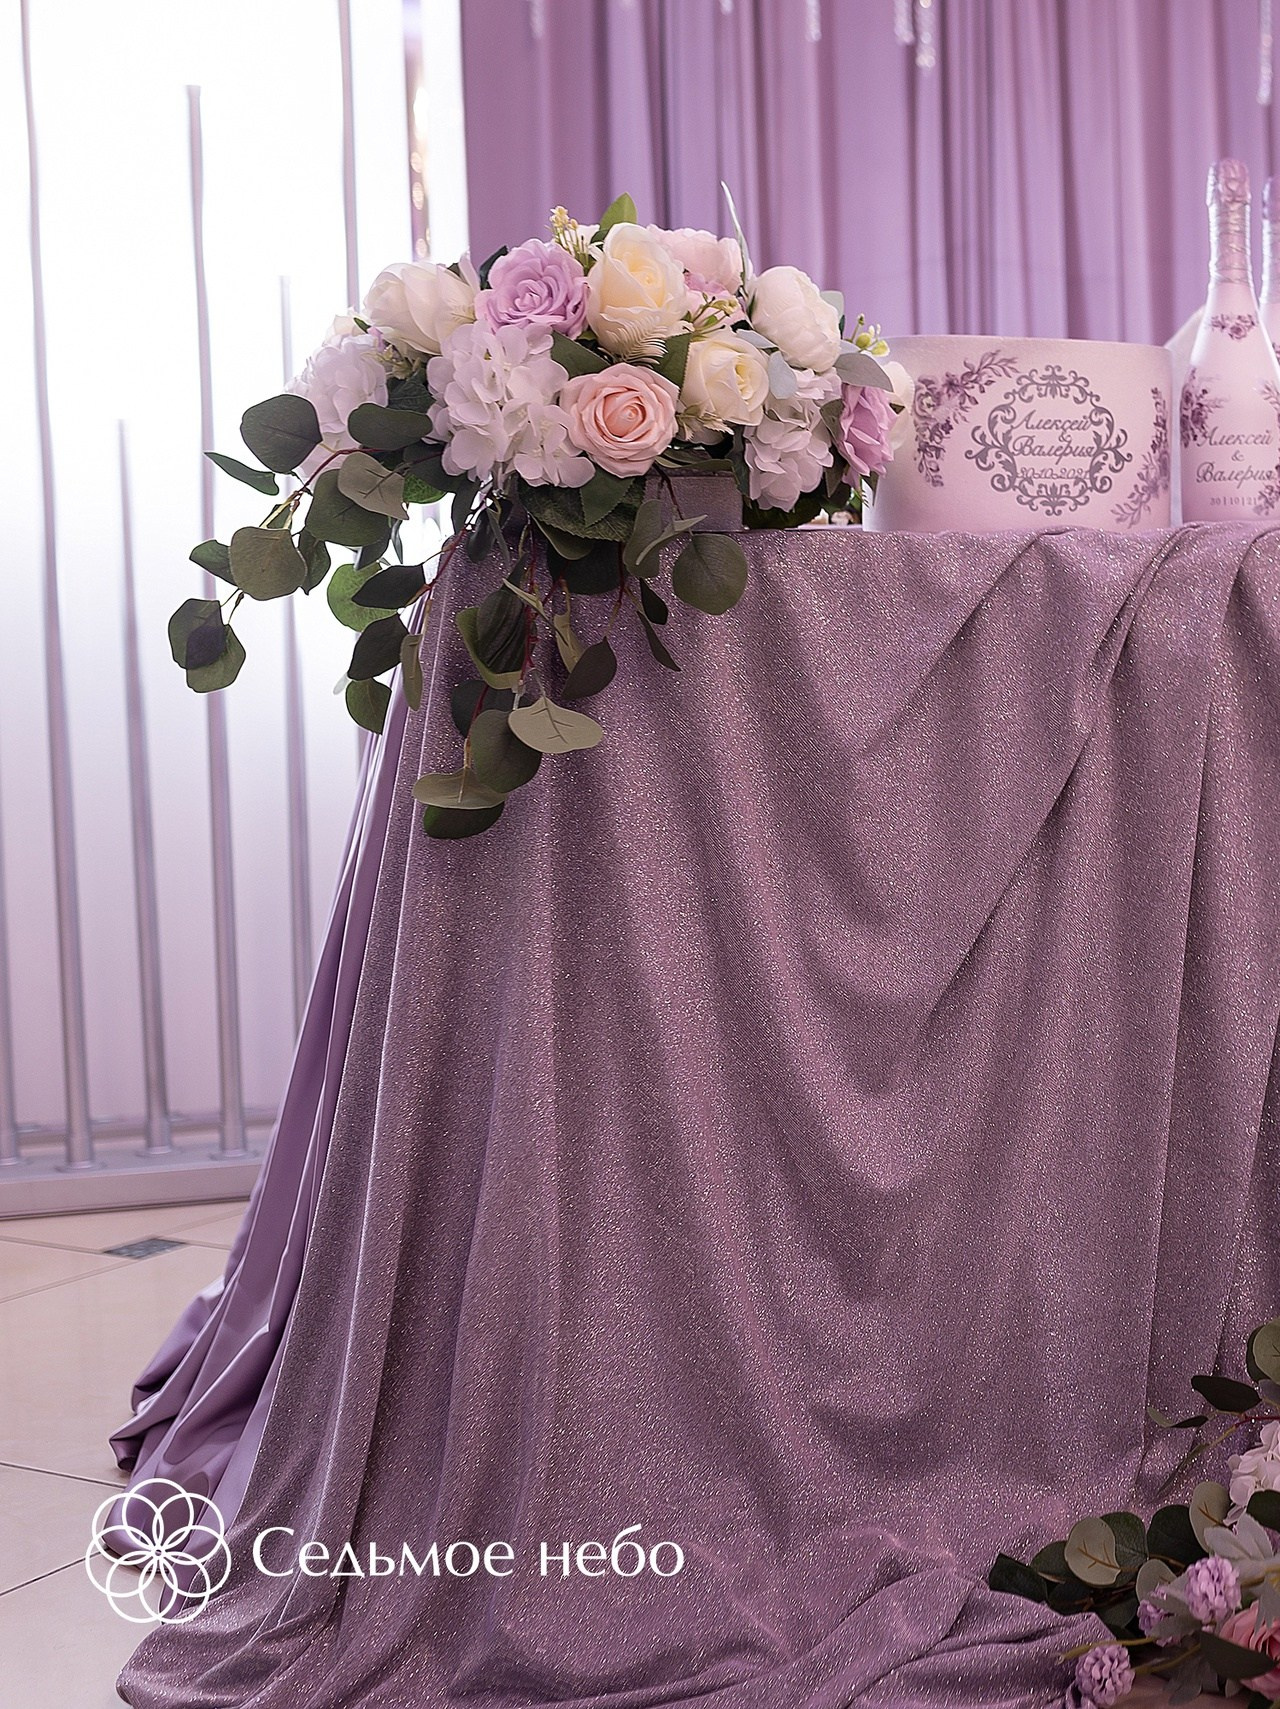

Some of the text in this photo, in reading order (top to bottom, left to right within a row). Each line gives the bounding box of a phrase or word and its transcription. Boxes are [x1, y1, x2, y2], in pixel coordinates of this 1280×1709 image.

[1009, 409, 1092, 431] Алексей
[1058, 430, 1073, 443] &
[1196, 426, 1273, 447] Алексей
[1011, 435, 1096, 465] Валерия
[1231, 450, 1245, 462] &
[1196, 461, 1276, 489] Валерия
